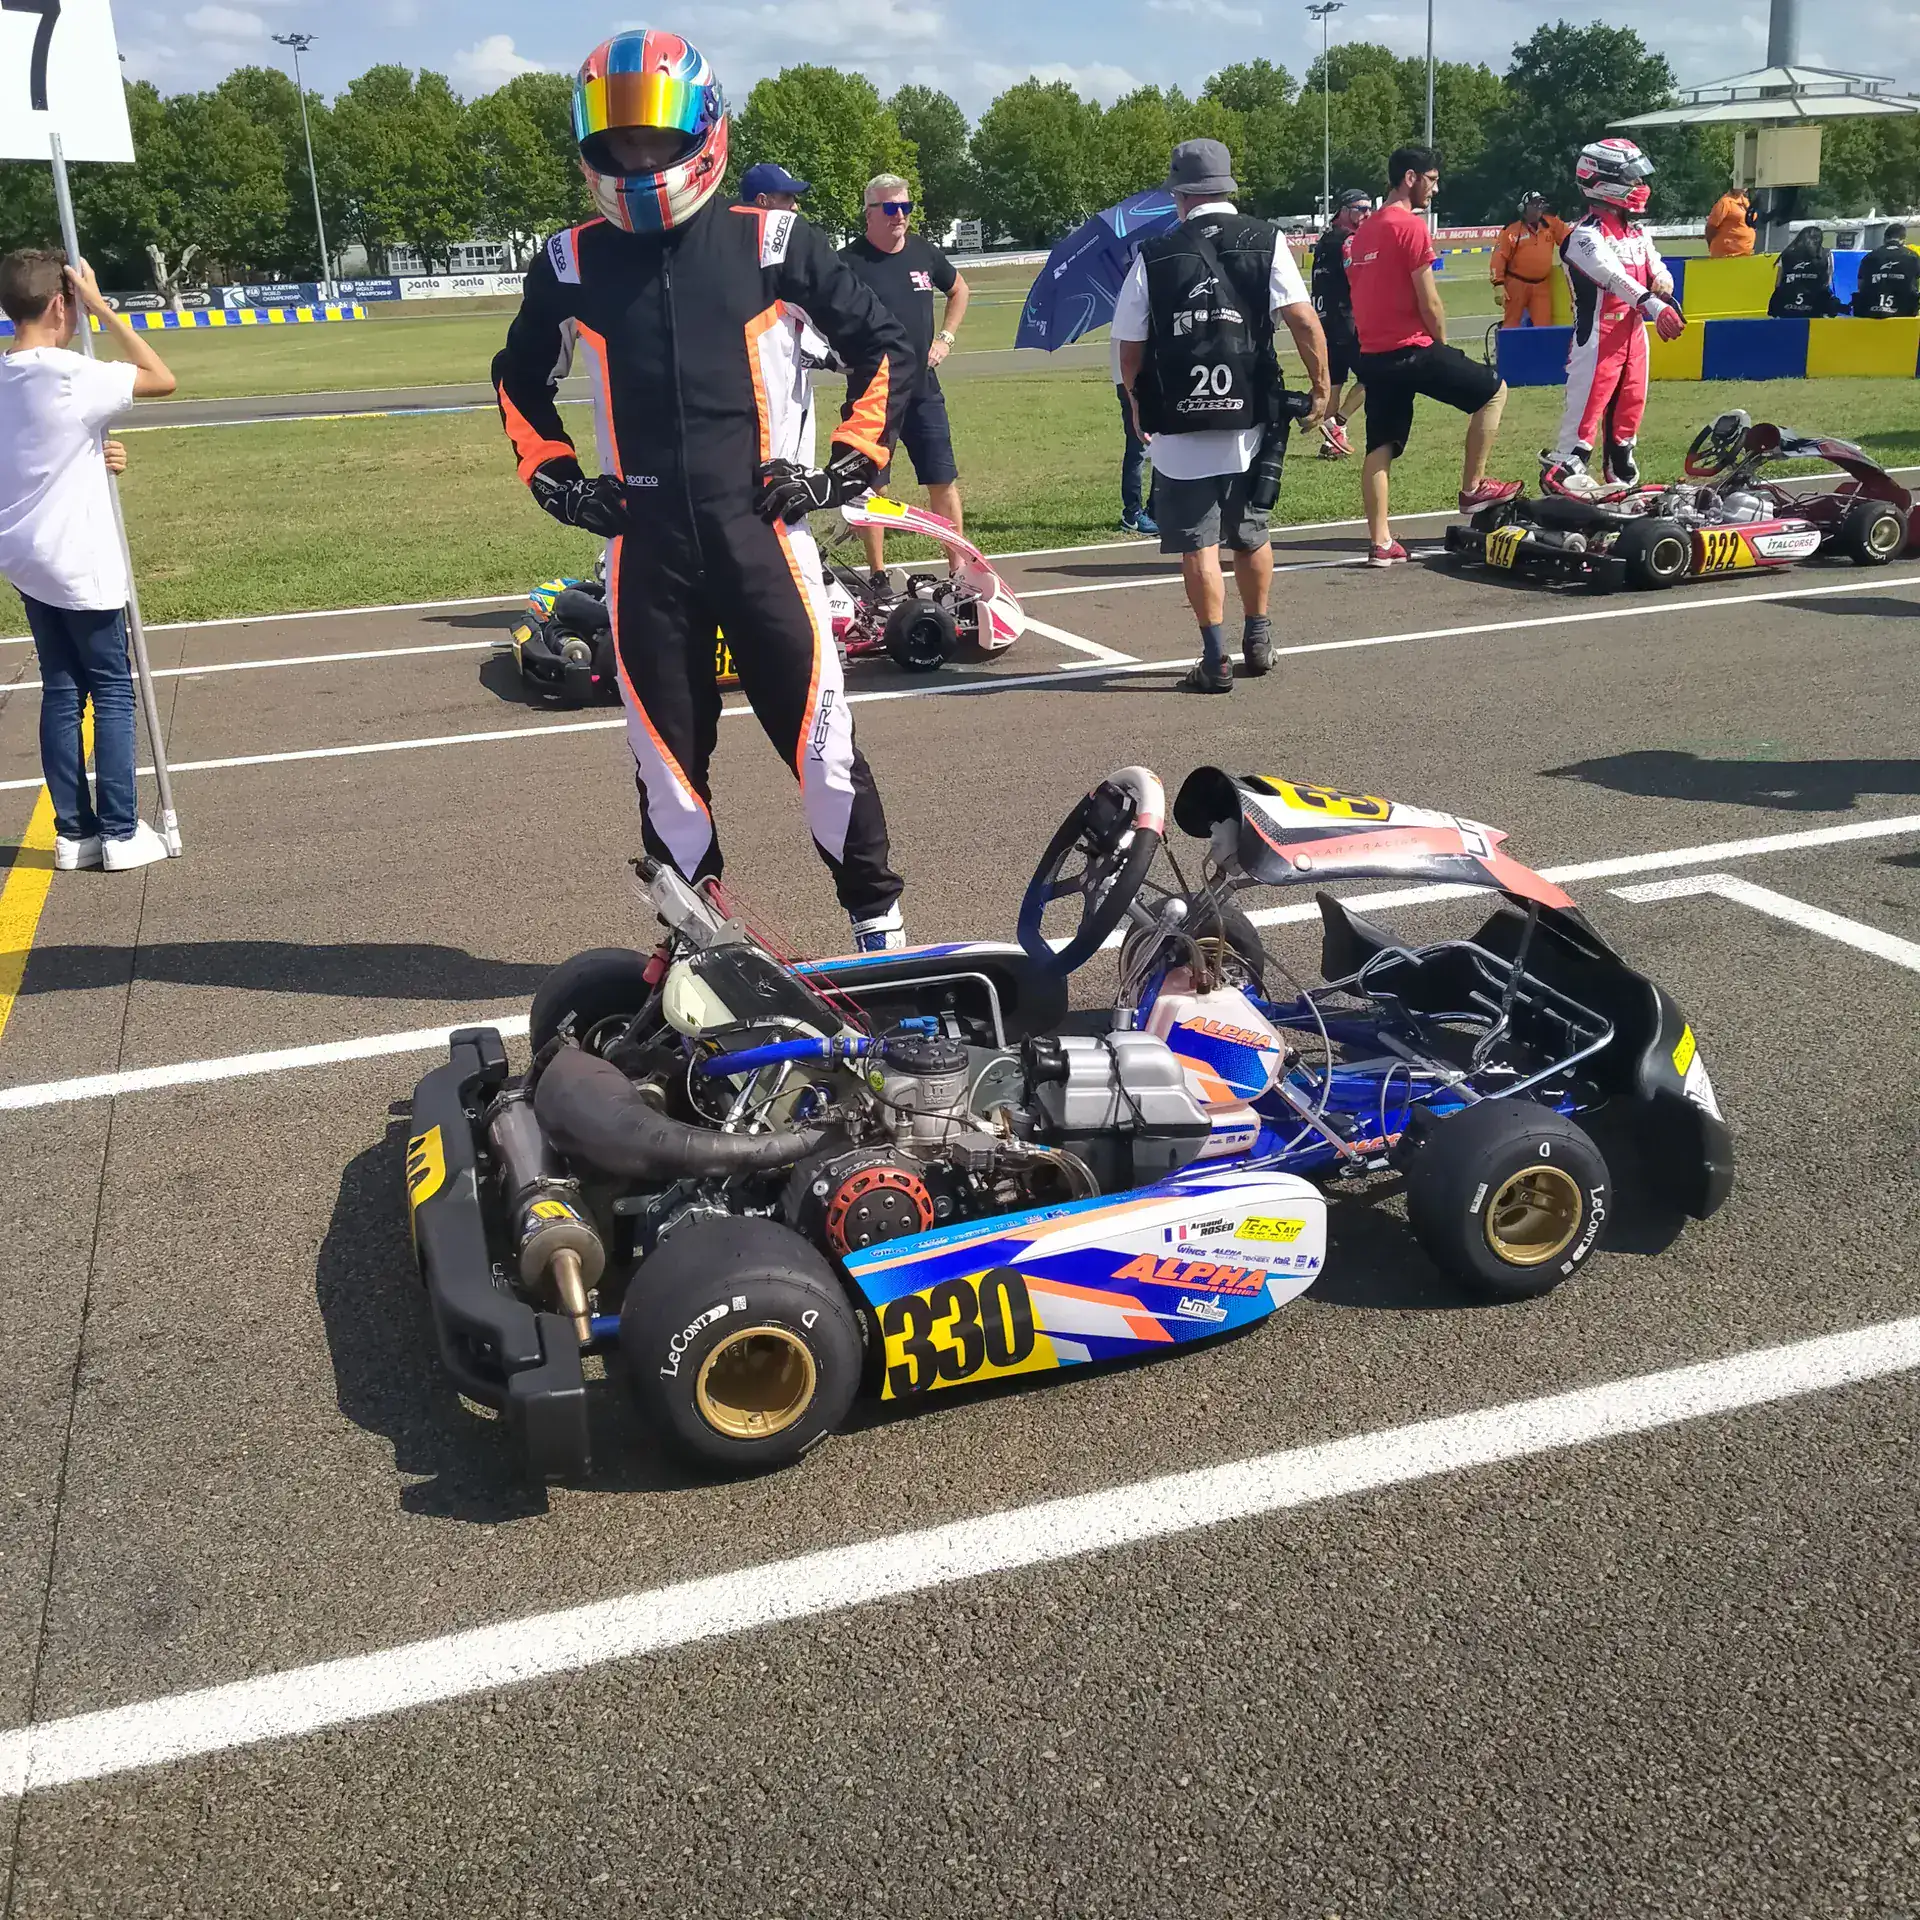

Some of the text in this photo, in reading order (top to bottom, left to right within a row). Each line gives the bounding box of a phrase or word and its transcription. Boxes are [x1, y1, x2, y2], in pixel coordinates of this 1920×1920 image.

[1, 0, 61, 111] 7
[771, 215, 788, 252] sparco
[1449, 230, 1479, 239] MOTUL
[1482, 229, 1500, 238] MOT
[497, 275, 521, 287] pant
[1795, 293, 1804, 305] 5
[1880, 294, 1894, 308] 15
[1190, 364, 1233, 397] 20
[1176, 398, 1245, 413] alpinestars
[626, 474, 658, 484] sparco
[1705, 531, 1739, 571] 322
[811, 690, 835, 762] KERB
[1179, 1016, 1272, 1048] ALPHA
[1190, 1218, 1223, 1231] Arnaud
[1110, 1253, 1268, 1292] ALPHA
[883, 1266, 1035, 1399] 330
